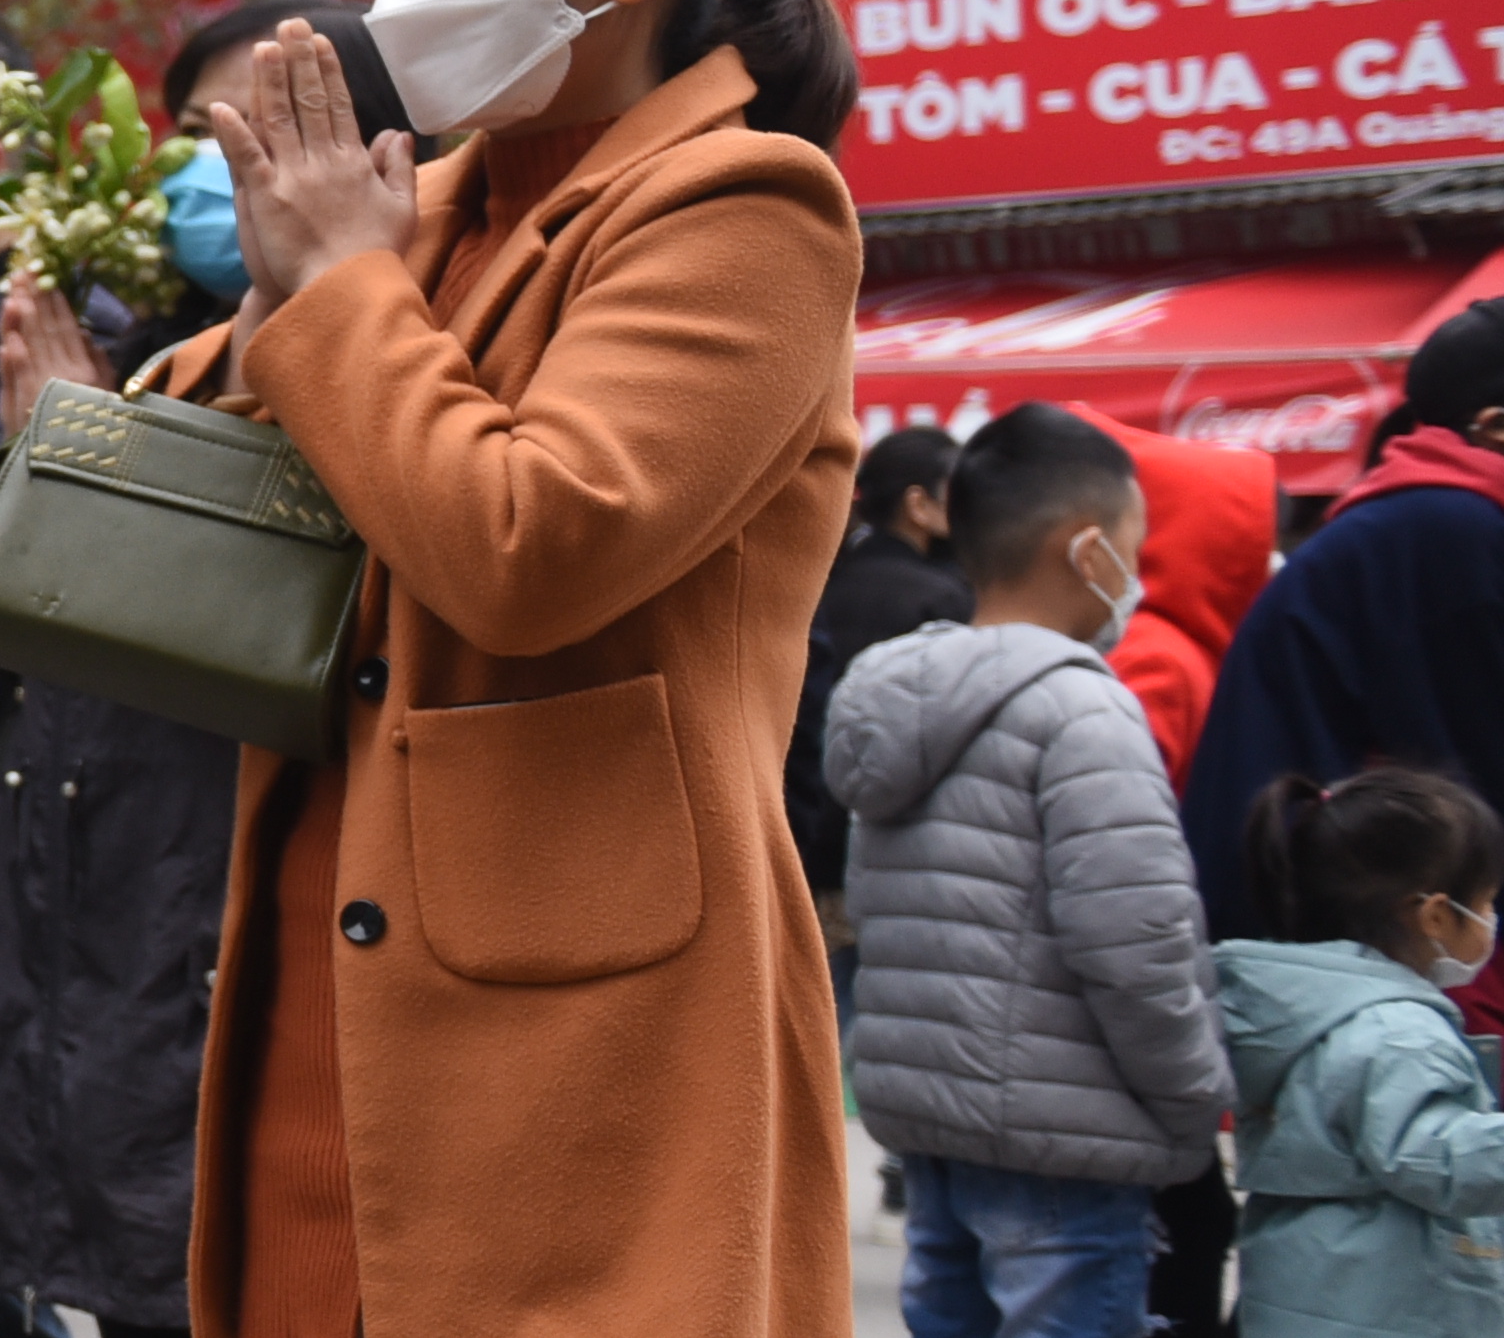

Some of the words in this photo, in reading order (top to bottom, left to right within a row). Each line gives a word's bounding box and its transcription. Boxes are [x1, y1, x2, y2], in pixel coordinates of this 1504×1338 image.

[859, 70, 1027, 144] TÔM
[1087, 52, 1268, 124] CUA
[1334, 22, 1466, 99] CÁ
